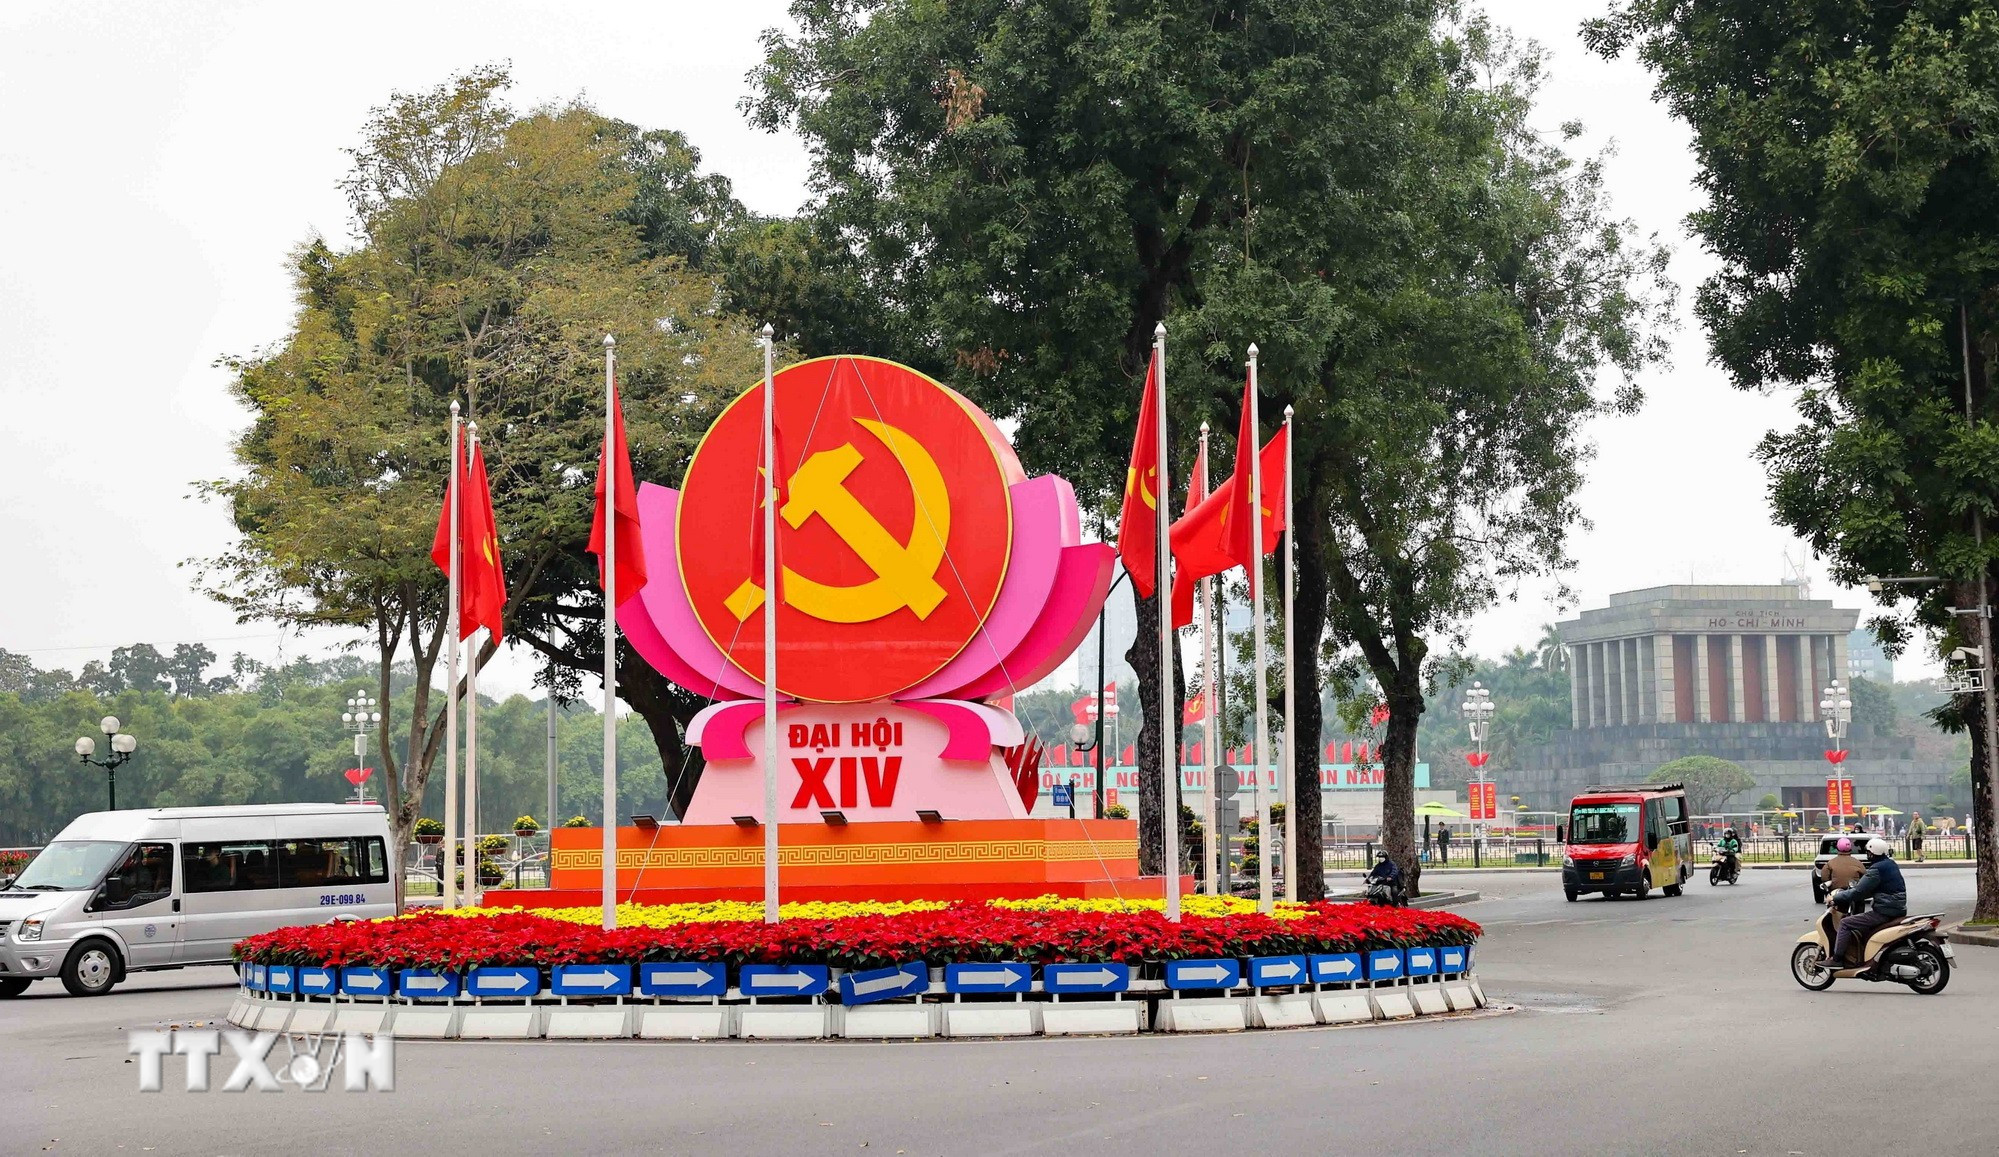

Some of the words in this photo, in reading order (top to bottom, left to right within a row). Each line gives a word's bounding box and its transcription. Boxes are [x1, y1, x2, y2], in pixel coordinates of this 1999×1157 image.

[788, 723, 841, 753] ĐẠI
[851, 717, 903, 752] HỘI
[790, 756, 903, 809] XIV
[1042, 770, 1062, 791] ỘI
[320, 893, 366, 906] 29E-099.84
